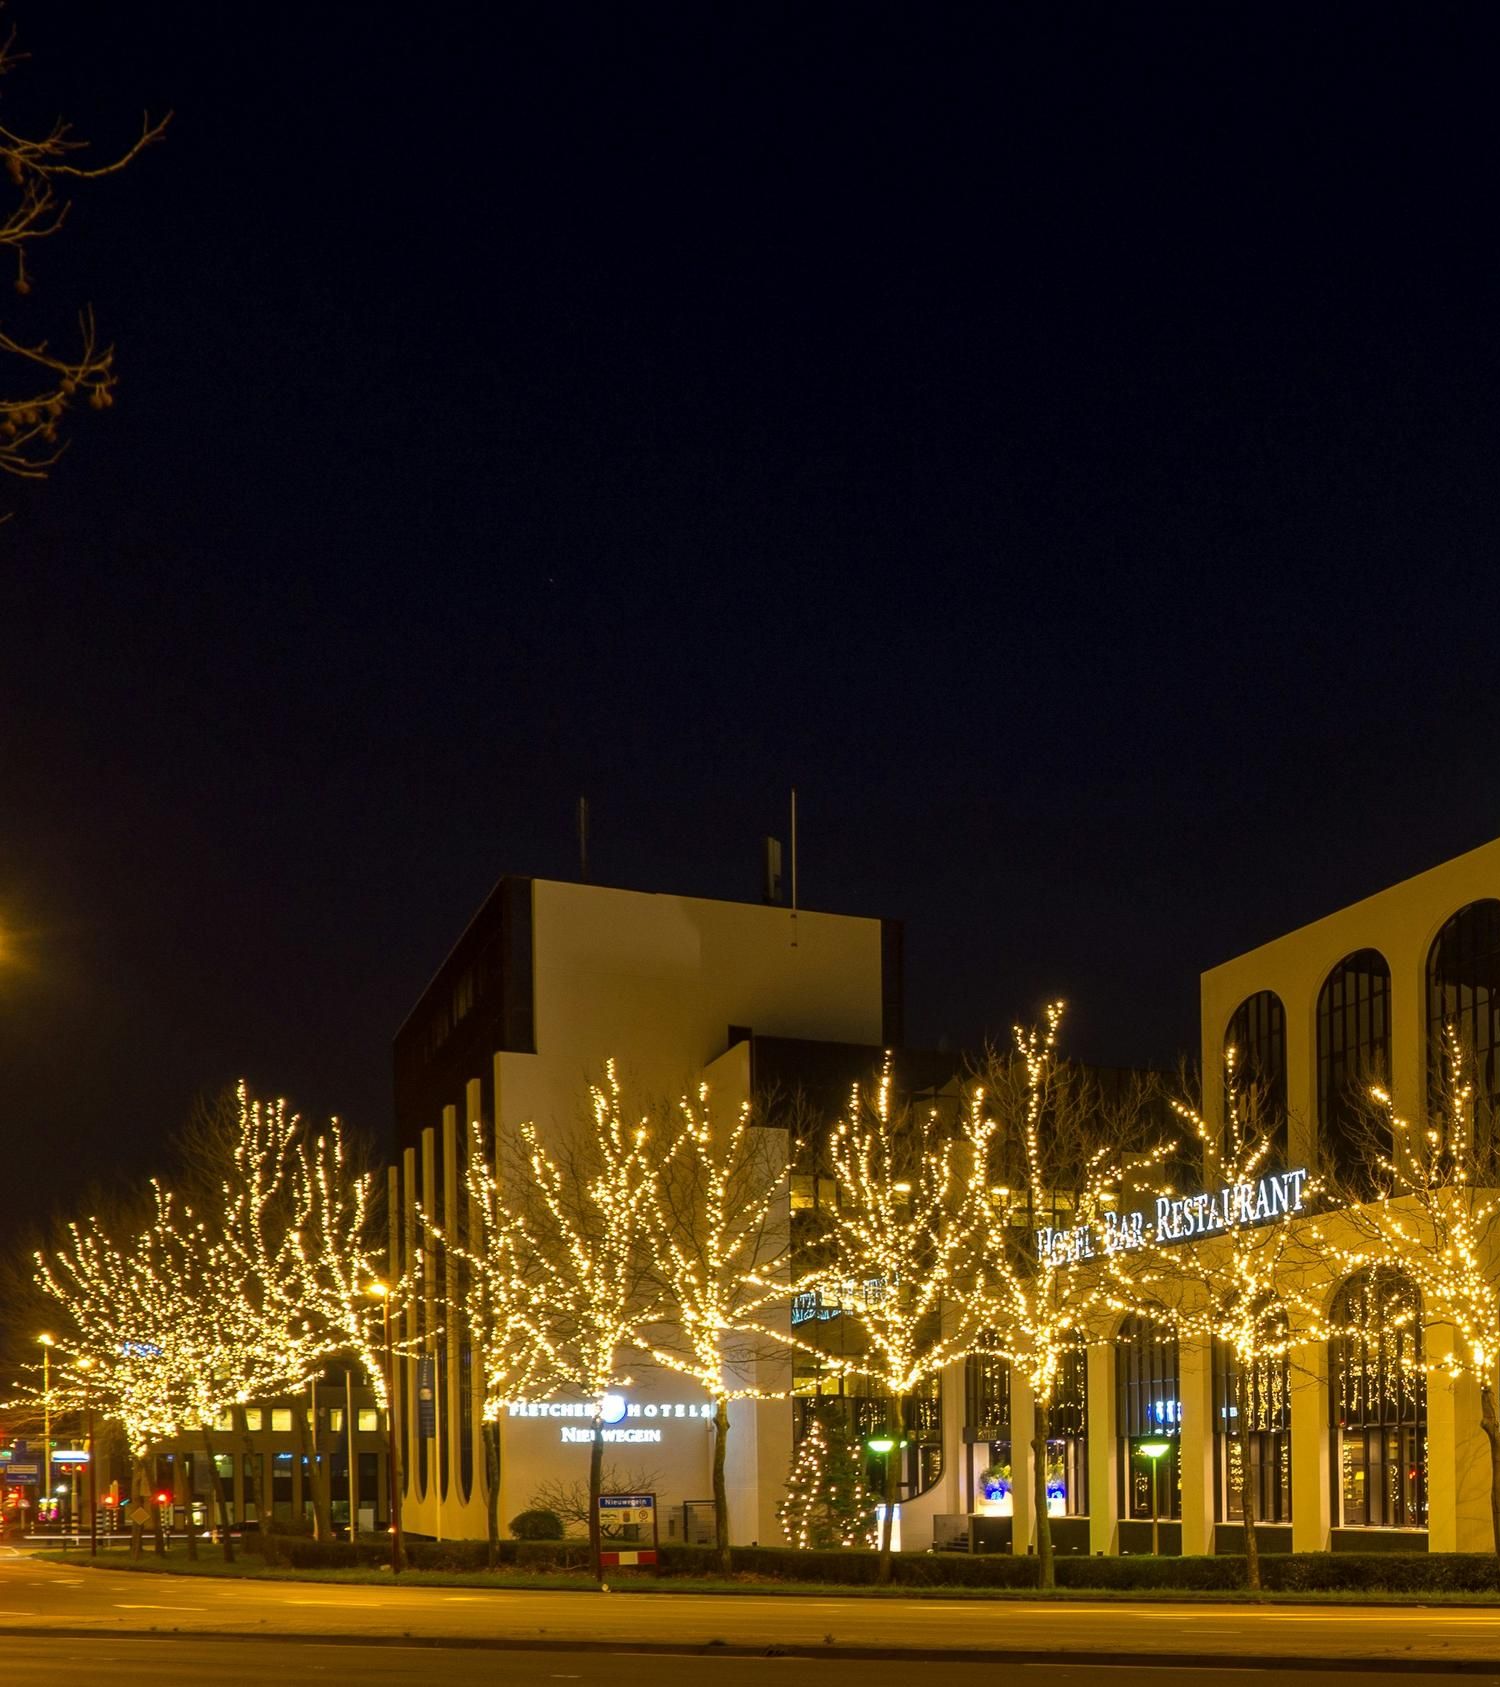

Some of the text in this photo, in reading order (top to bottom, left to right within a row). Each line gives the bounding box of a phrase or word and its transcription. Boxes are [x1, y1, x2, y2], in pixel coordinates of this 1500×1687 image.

[1104, 1211, 1147, 1254] BAR
[1155, 1168, 1306, 1243] RESTAURANT
[627, 1403, 712, 1418] HOTELS
